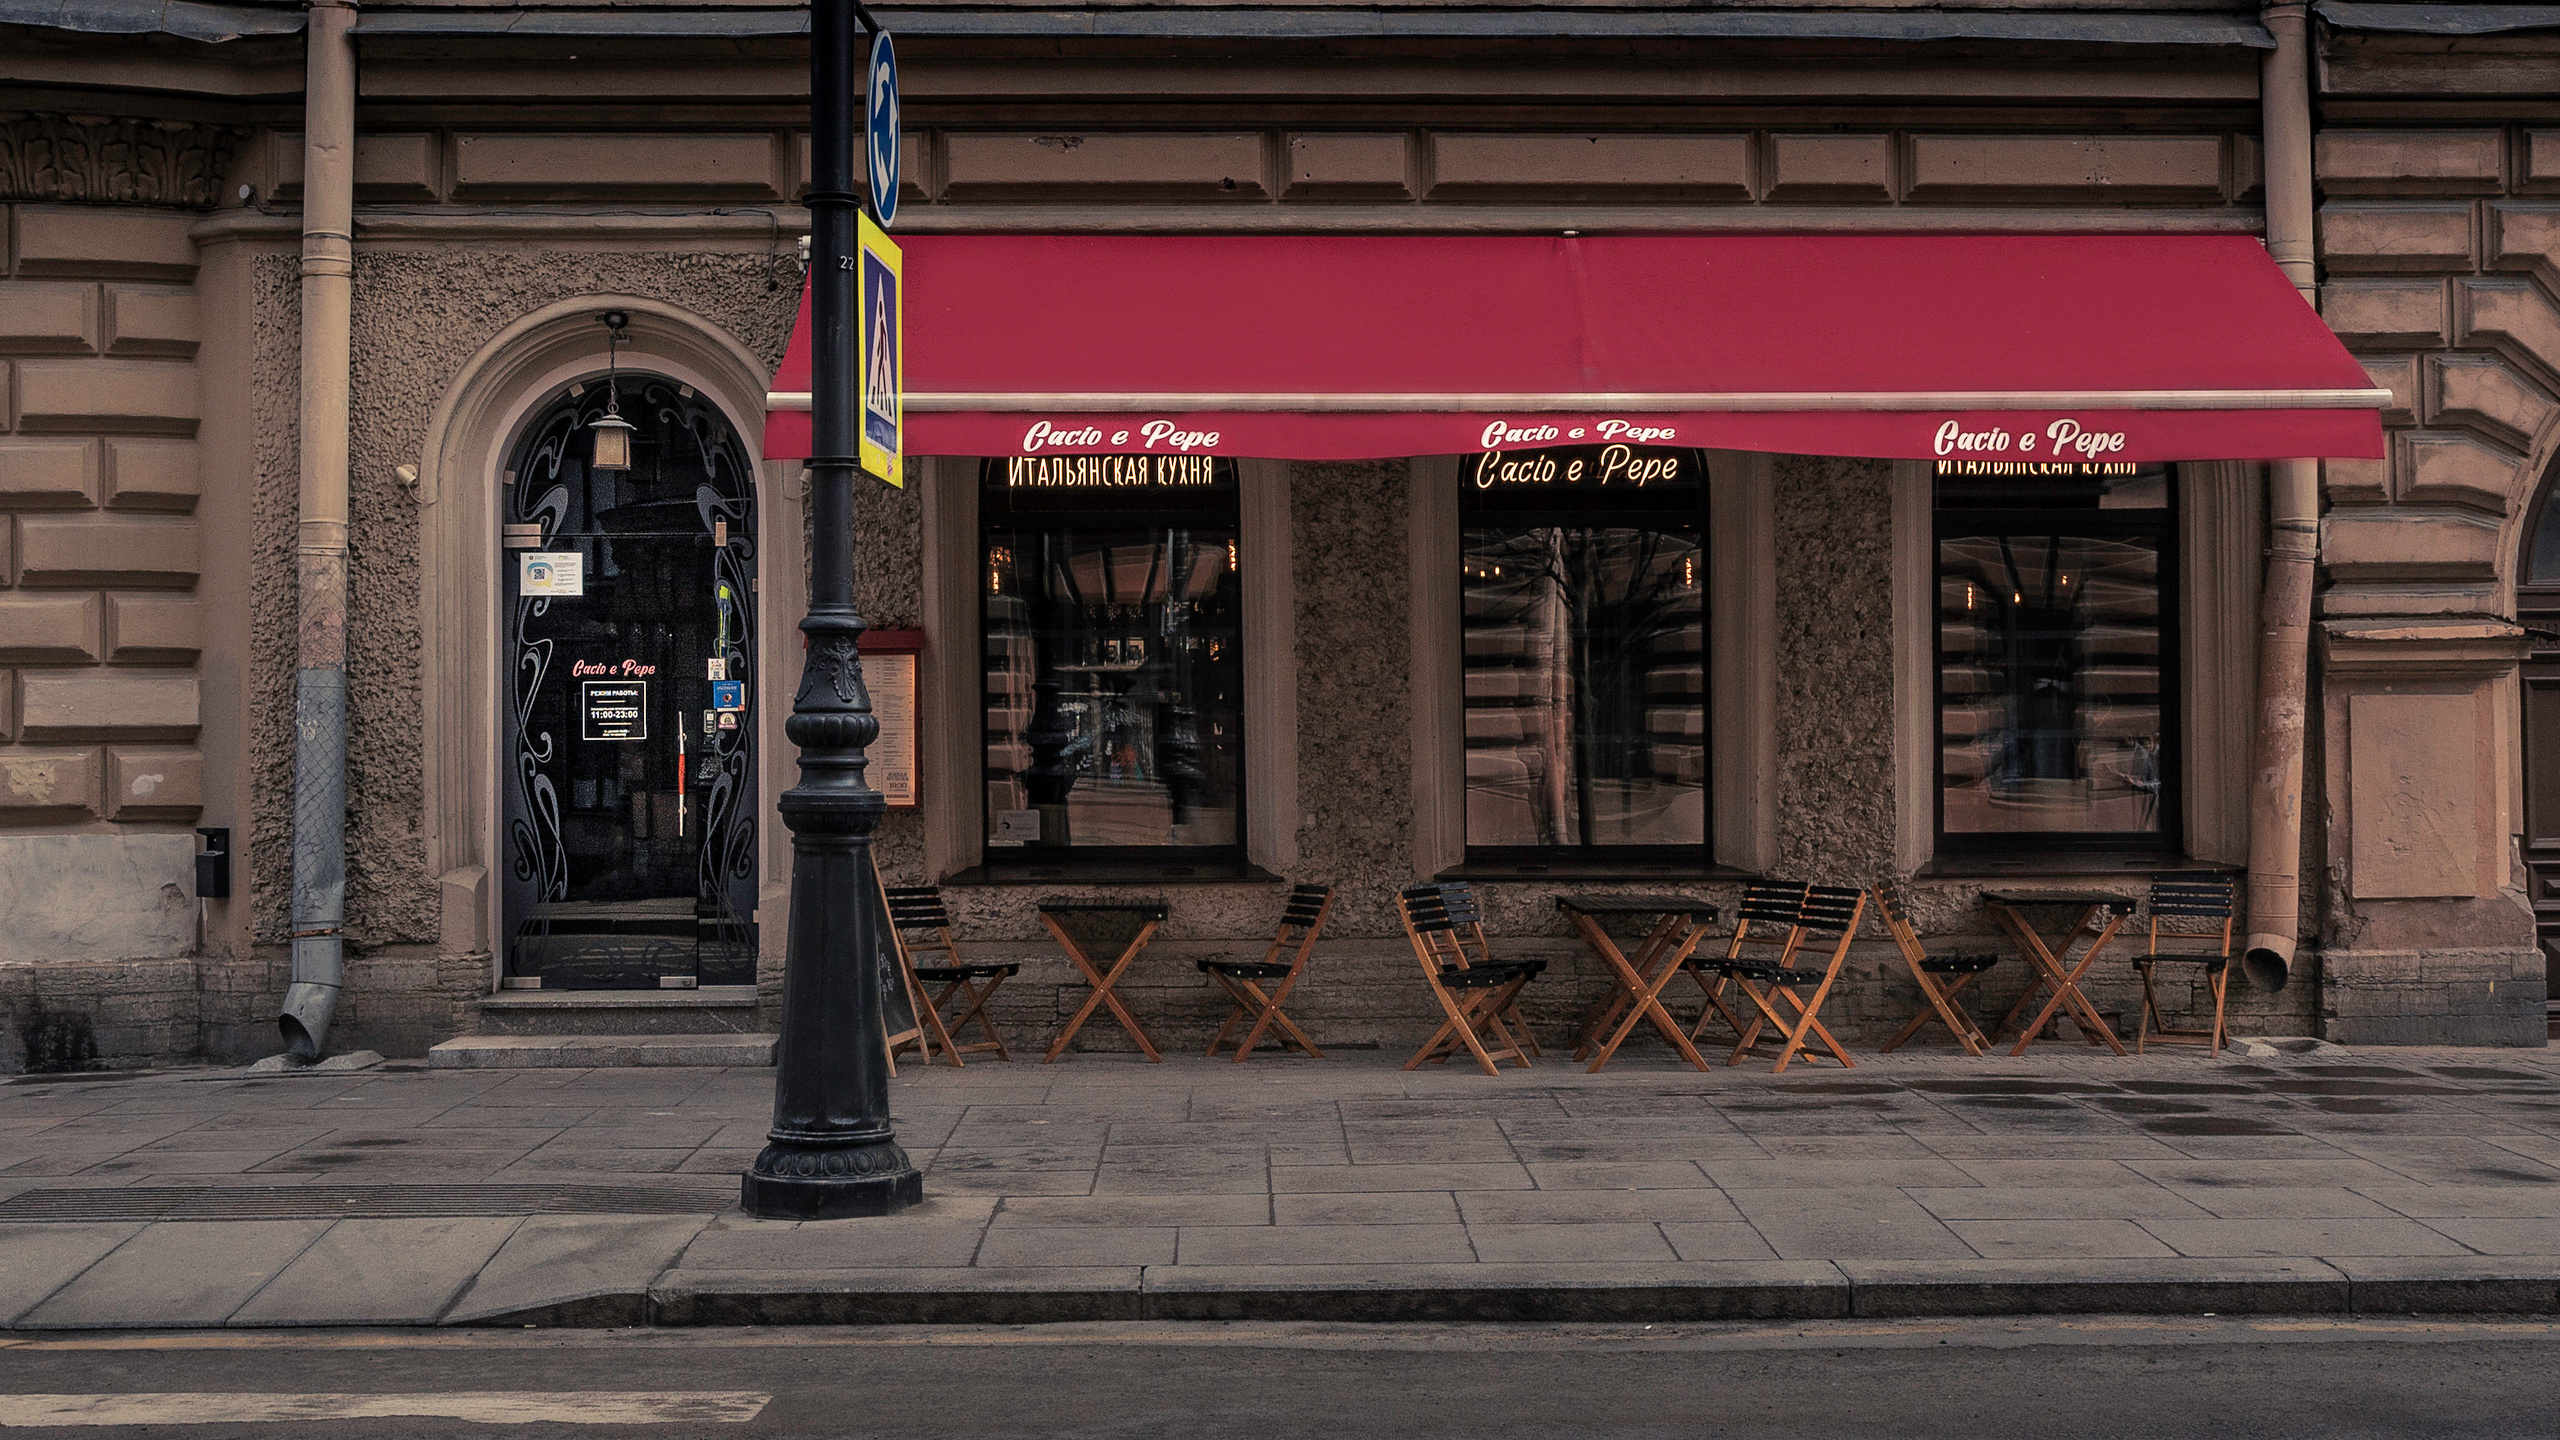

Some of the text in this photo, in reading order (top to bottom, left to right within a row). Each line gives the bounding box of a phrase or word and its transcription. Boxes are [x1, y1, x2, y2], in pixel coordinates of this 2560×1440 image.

[840, 255, 854, 270] 22
[1023, 420, 1220, 452] Cacio e Pepe
[1480, 419, 1675, 448] Cacio e Pepe
[1934, 418, 2125, 459] Cacio e Pepe
[1008, 455, 1213, 487] ИТАЛЬЯНСКАЯ КУХНЯ
[1476, 444, 1678, 489] Cacio e Pepe
[572, 658, 656, 678] Cacio e Pepe
[590, 710, 639, 719] 11:00-23:00
